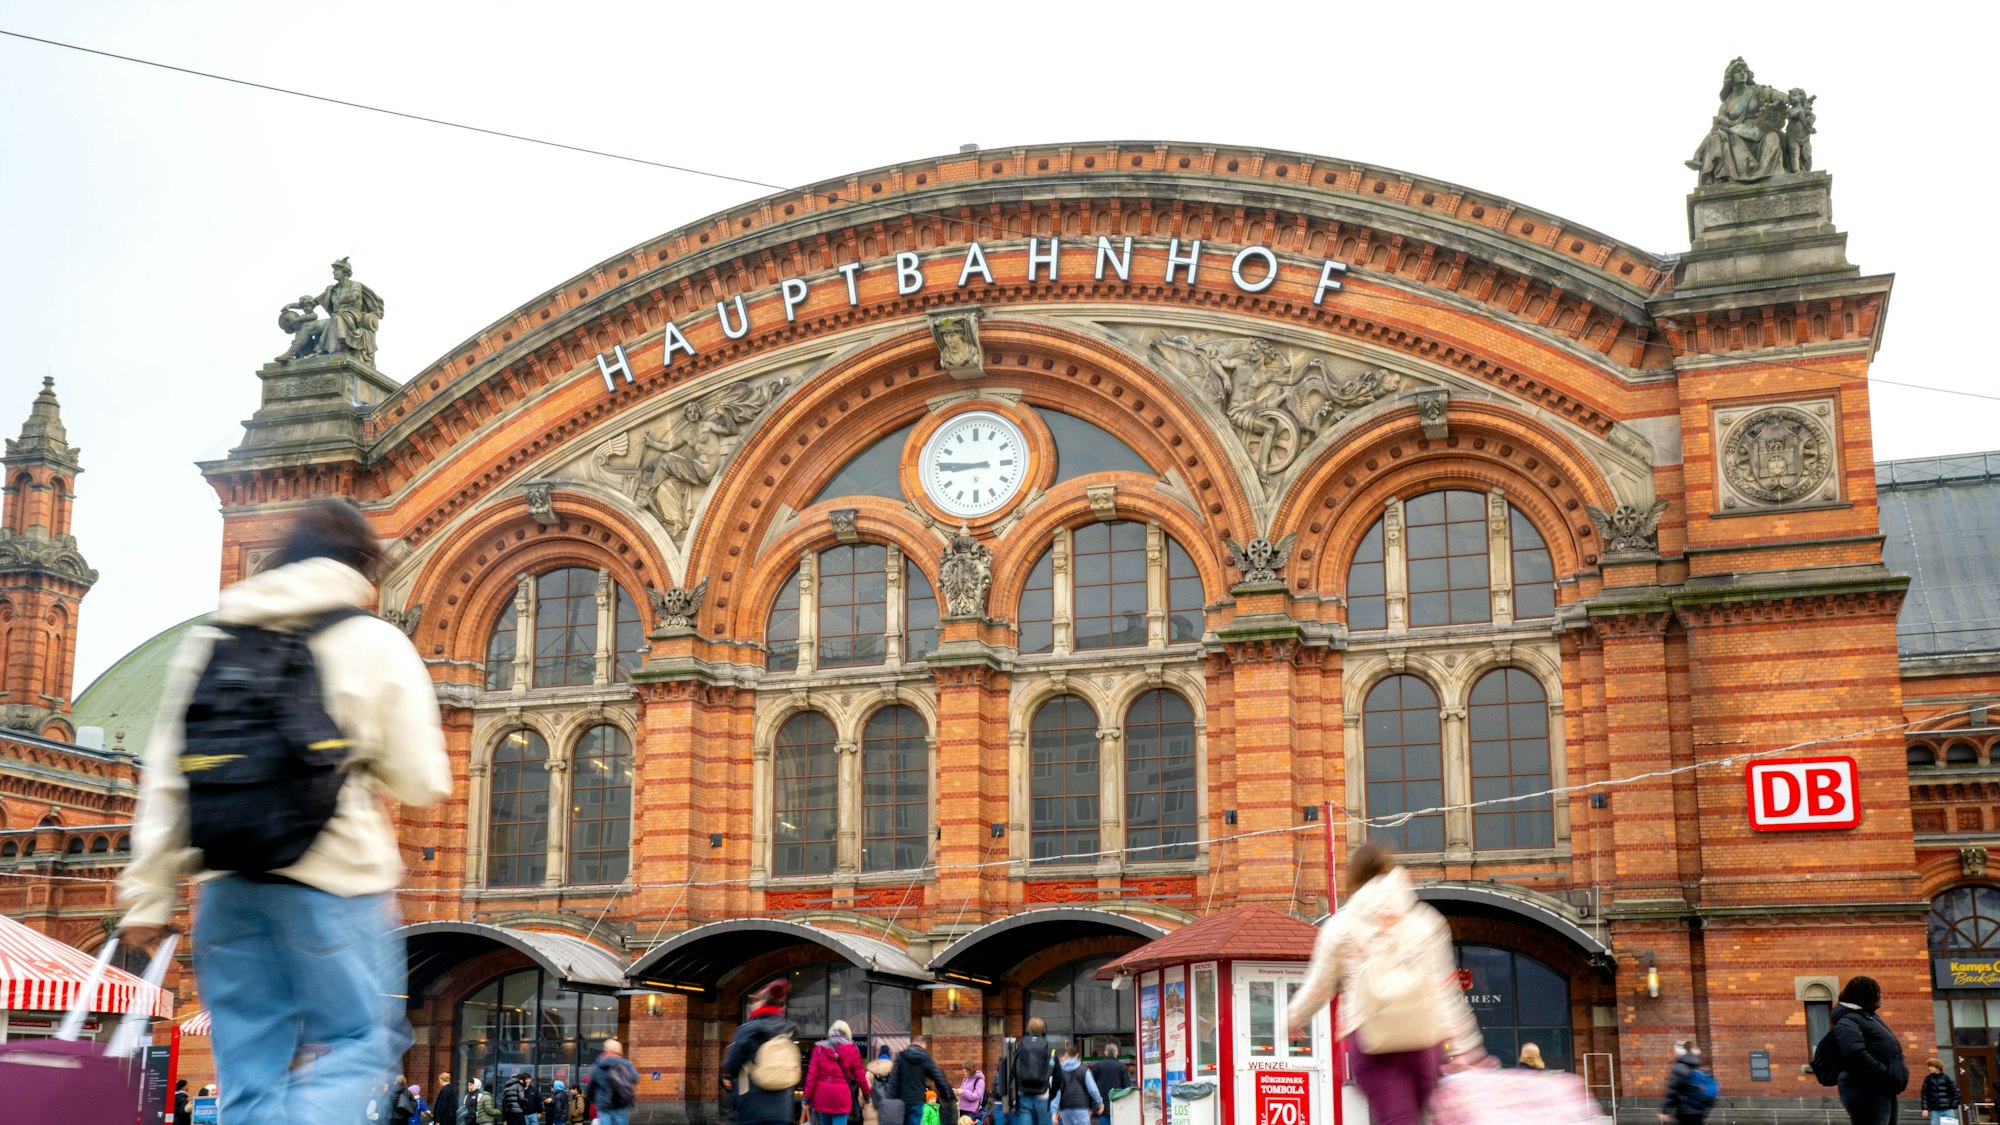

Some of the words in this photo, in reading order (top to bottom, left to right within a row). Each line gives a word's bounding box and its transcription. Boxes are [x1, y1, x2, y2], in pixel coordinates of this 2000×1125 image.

[596, 235, 1349, 394] HAUPTBAHNHOF
[1761, 768, 1846, 818] DB
[1950, 961, 1992, 974] Kamps
[1248, 1061, 1289, 1070] WENZEL
[1260, 1075, 1305, 1084] BÜRGERPARK-
[1260, 1085, 1305, 1095] TOMBOLA
[1269, 1103, 1297, 1125] 70
